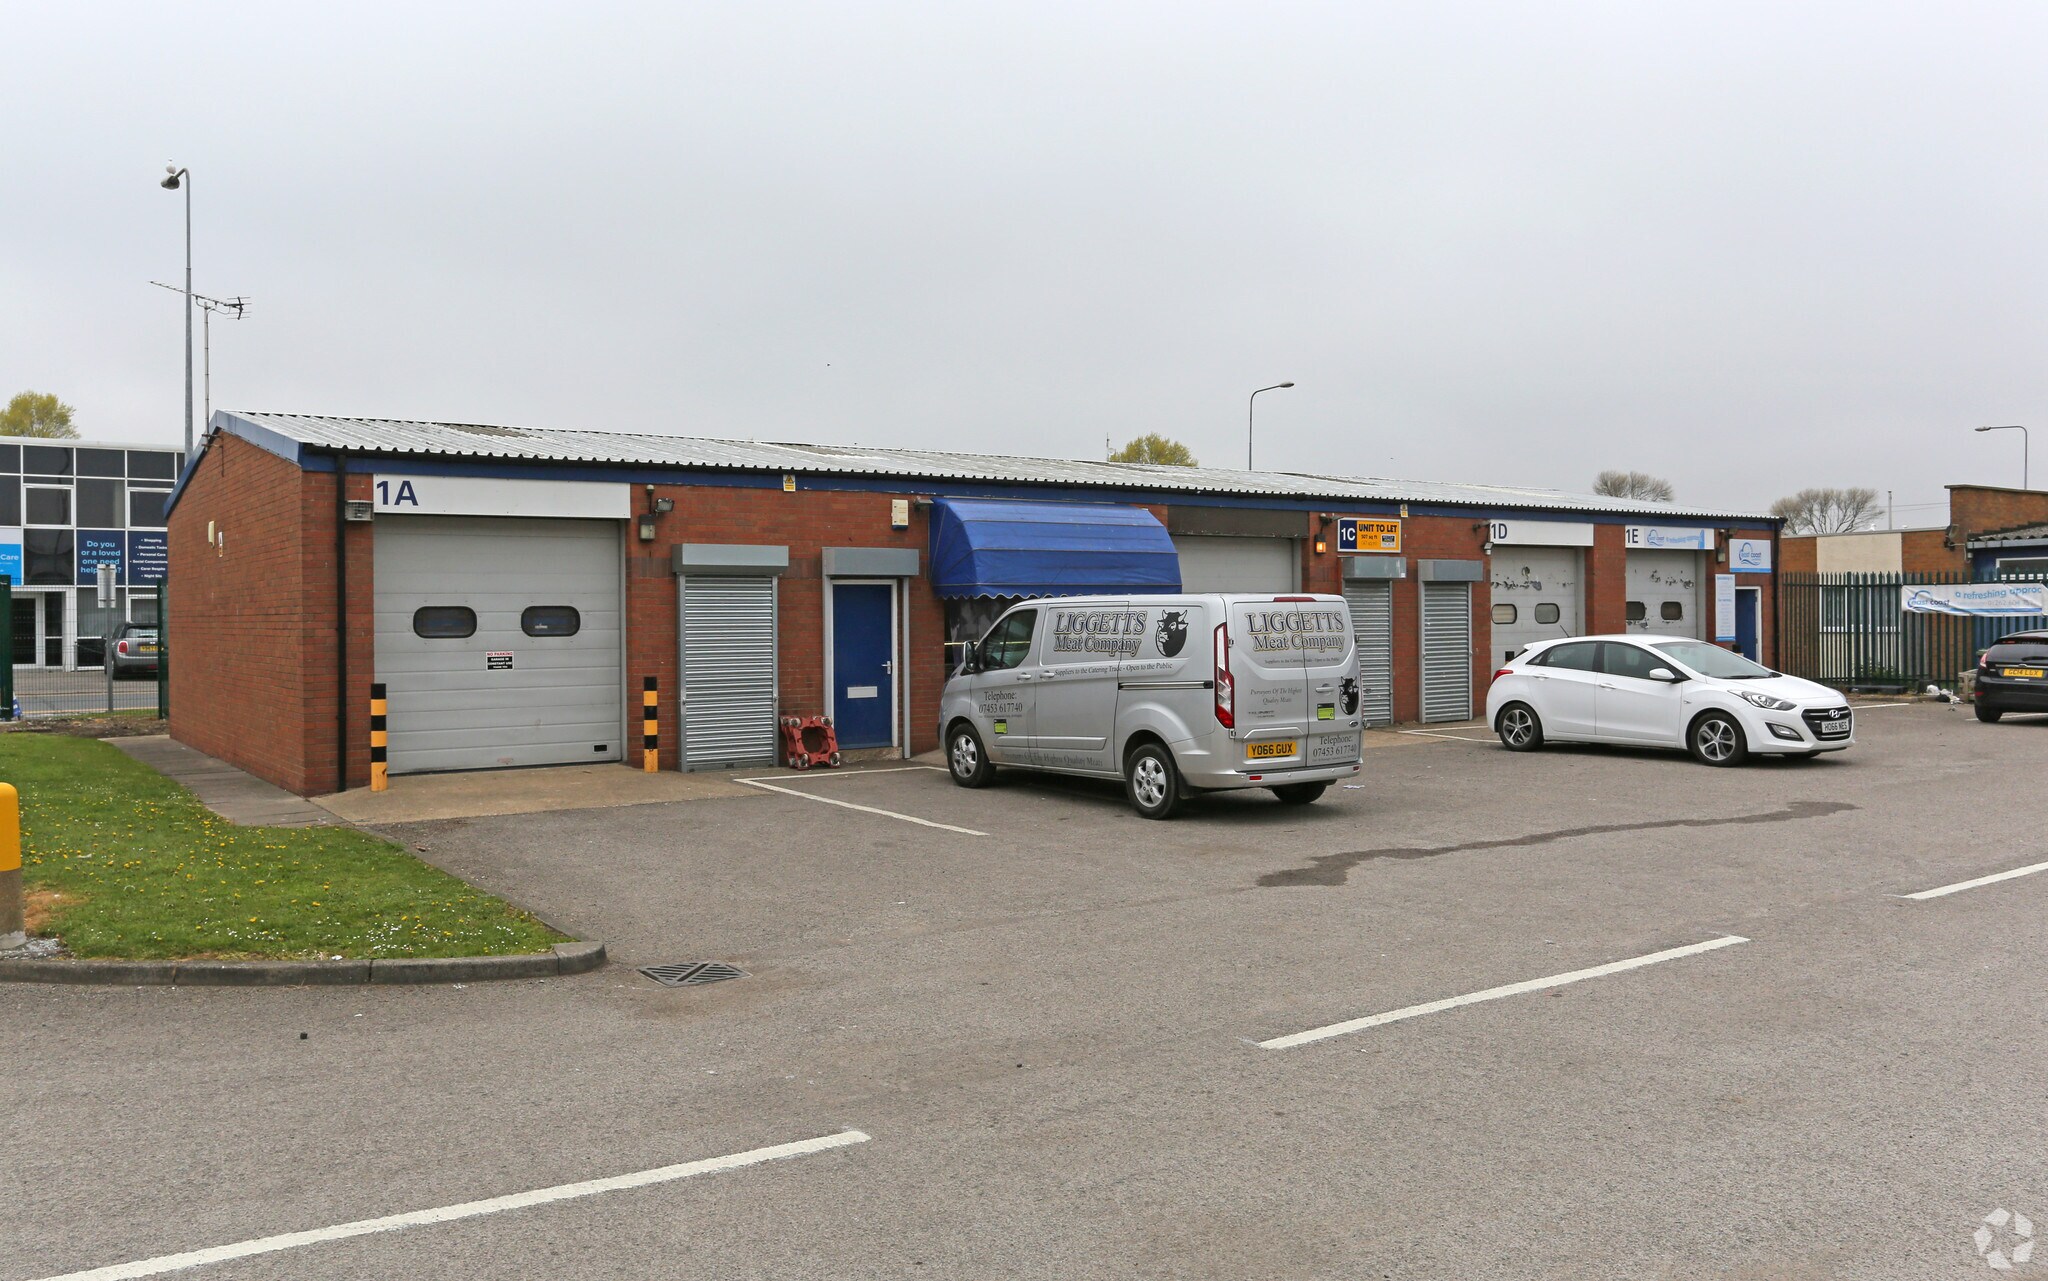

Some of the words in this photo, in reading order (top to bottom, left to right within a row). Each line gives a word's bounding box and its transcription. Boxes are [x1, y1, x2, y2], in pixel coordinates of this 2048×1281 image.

[377, 480, 419, 506] 1A
[1341, 527, 1356, 541] 1C
[1358, 523, 1374, 533] UNIT
[1376, 524, 1386, 533] TO
[1386, 524, 1397, 533] LET
[1491, 522, 1508, 540] 1D
[1626, 528, 1639, 544] 1E
[86, 540, 99, 548] Do
[1963, 589, 2007, 600] refreshing
[1929, 598, 1950, 606] coast
[1053, 611, 1147, 635] LIGGETTS
[1245, 611, 1345, 635] LIGGETTS
[1053, 634, 1082, 652] Meat
[1083, 632, 1142, 657] Company
[1252, 634, 1289, 652] Meat
[1291, 633, 1346, 653] Company
[1055, 668, 1075, 676] Suppliers
[1088, 665, 1108, 674] Catering
[1126, 663, 1140, 671] Open
[984, 691, 1017, 703] Telephone:
[979, 703, 998, 714] 07453
[999, 702, 1023, 713] 617740
[1320, 734, 1353, 746] Telephone:
[1276, 743, 1293, 754] GUX
[1312, 747, 1334, 758] 07453
